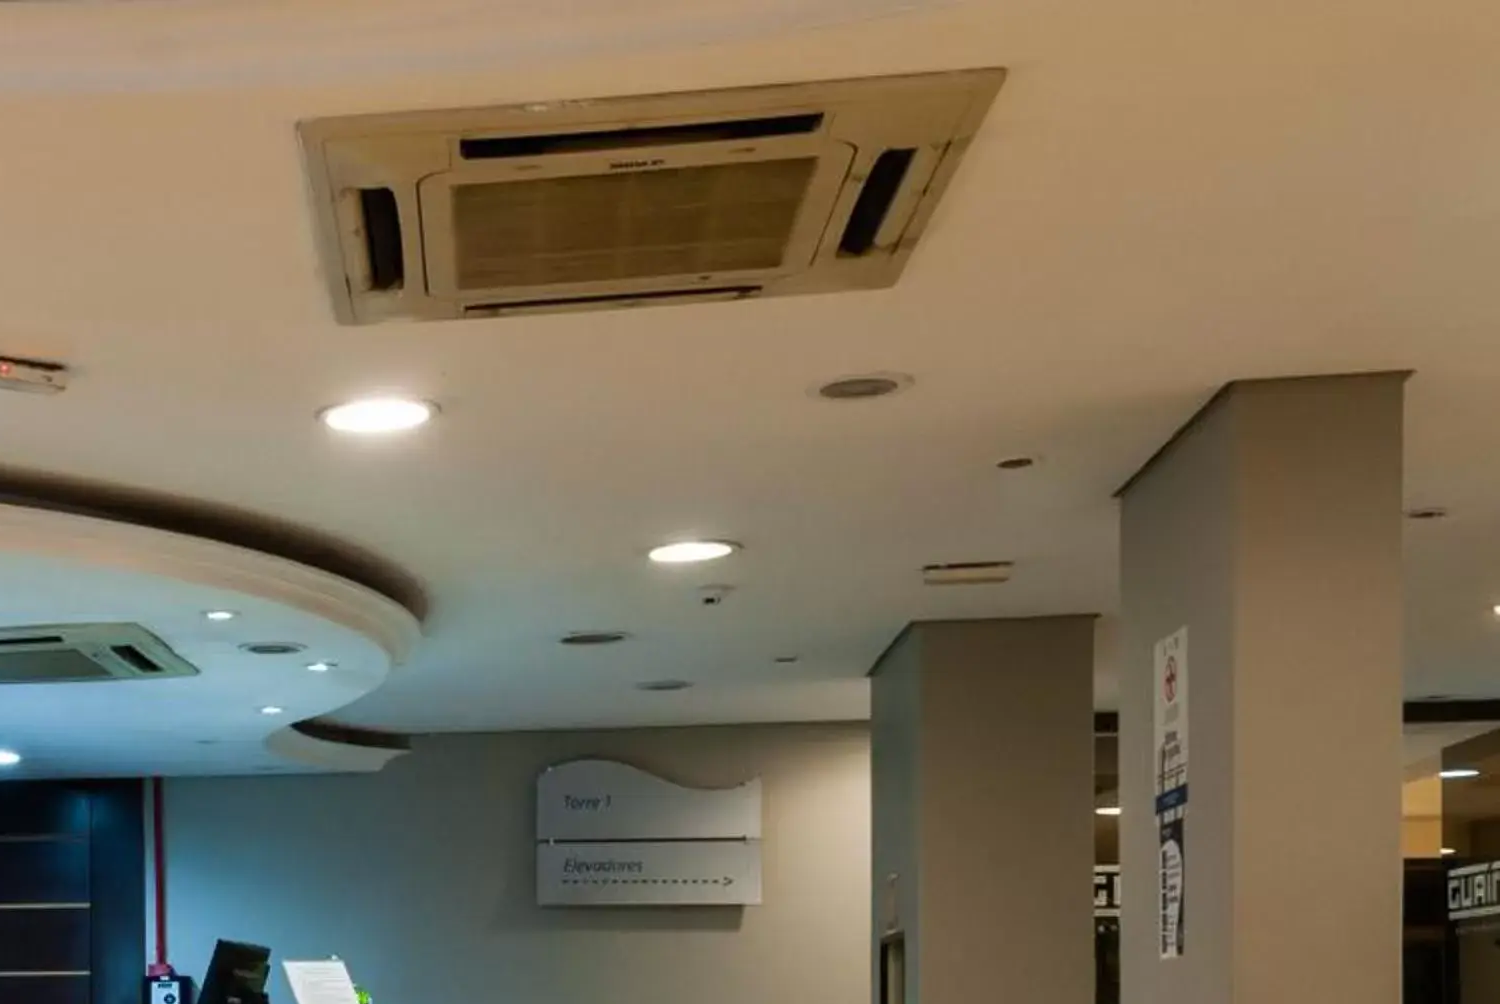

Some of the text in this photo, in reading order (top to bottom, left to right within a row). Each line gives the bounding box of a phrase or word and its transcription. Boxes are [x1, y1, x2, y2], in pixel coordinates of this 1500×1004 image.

[563, 794, 612, 811] Torre 1
[562, 857, 644, 874] Elevadores
